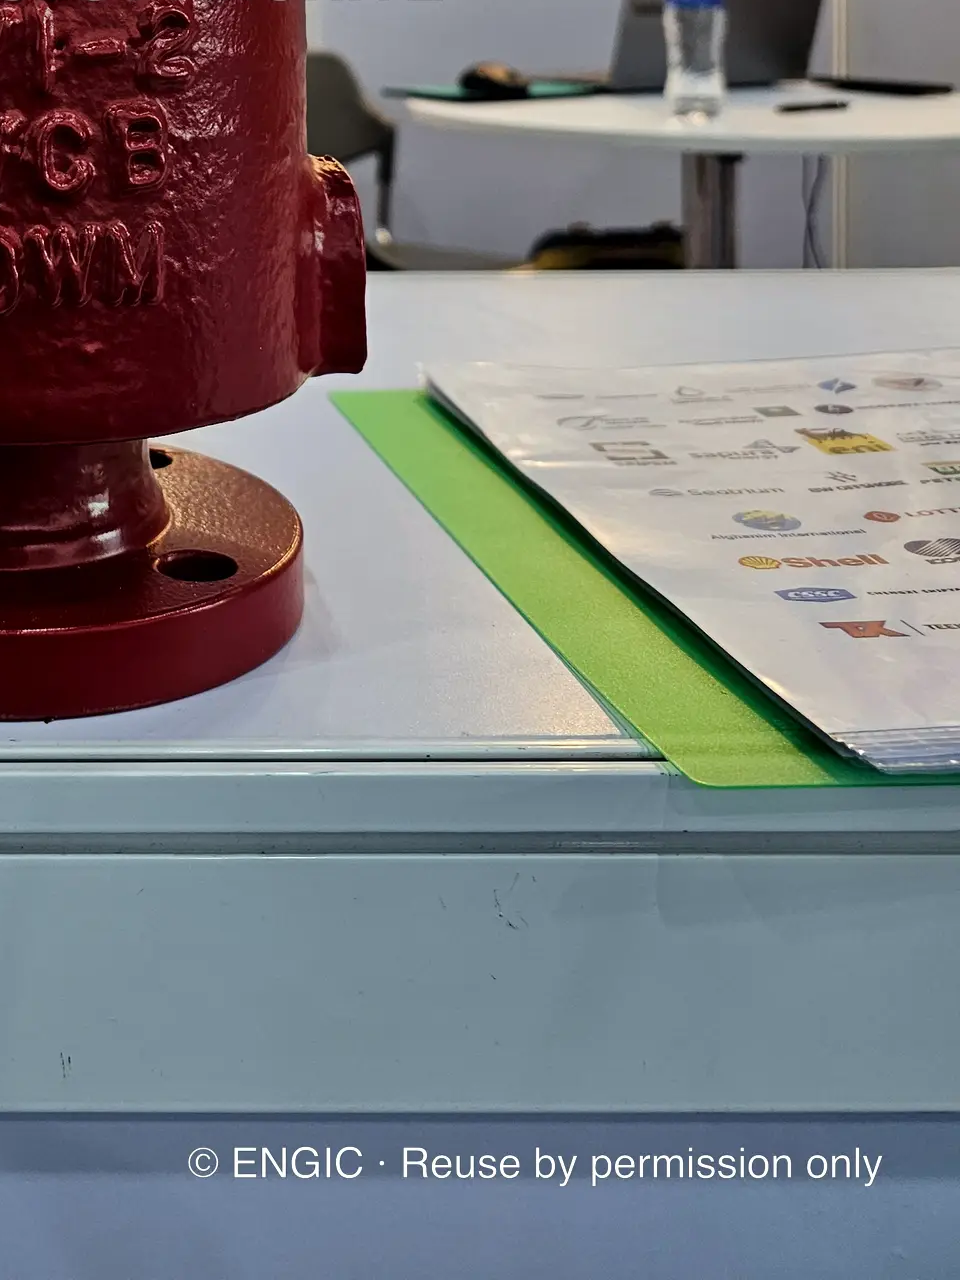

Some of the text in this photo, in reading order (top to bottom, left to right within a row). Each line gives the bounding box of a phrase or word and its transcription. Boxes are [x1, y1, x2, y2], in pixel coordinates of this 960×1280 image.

[828, 440, 893, 454] eni
[687, 487, 785, 497] Seatrium
[904, 506, 960, 518] LOTT
[778, 528, 867, 539] International
[780, 553, 891, 568] Shell
[787, 590, 841, 599] CSSC
